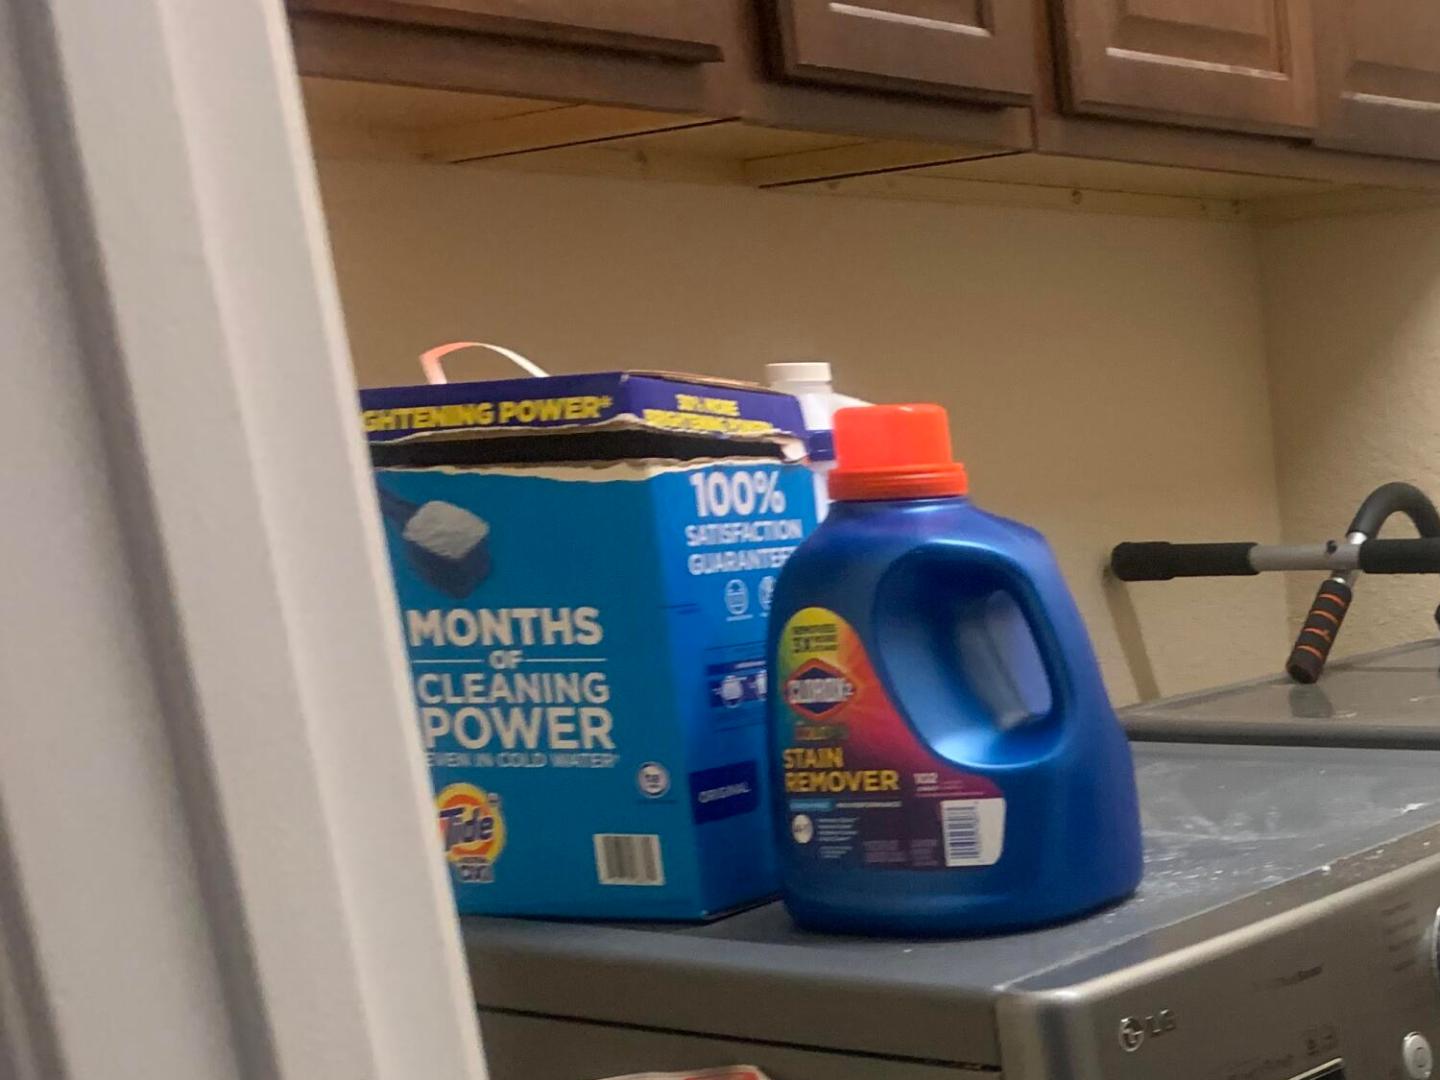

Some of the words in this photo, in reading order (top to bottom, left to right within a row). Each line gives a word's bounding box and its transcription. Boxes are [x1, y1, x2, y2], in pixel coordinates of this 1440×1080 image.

[362, 401, 494, 432] GHTENING
[689, 470, 787, 517] 100%
[684, 518, 803, 547] SATISFACTION
[687, 545, 798, 576] GUARANTEE
[406, 606, 604, 647] MONTHS
[488, 649, 523, 670] OF
[417, 671, 611, 704] CLEANING
[421, 706, 617, 750] POWER
[496, 752, 548, 768] COLD
[783, 746, 845, 769] STAIN
[784, 769, 900, 793] REMOVER
[439, 806, 494, 852] Tide
